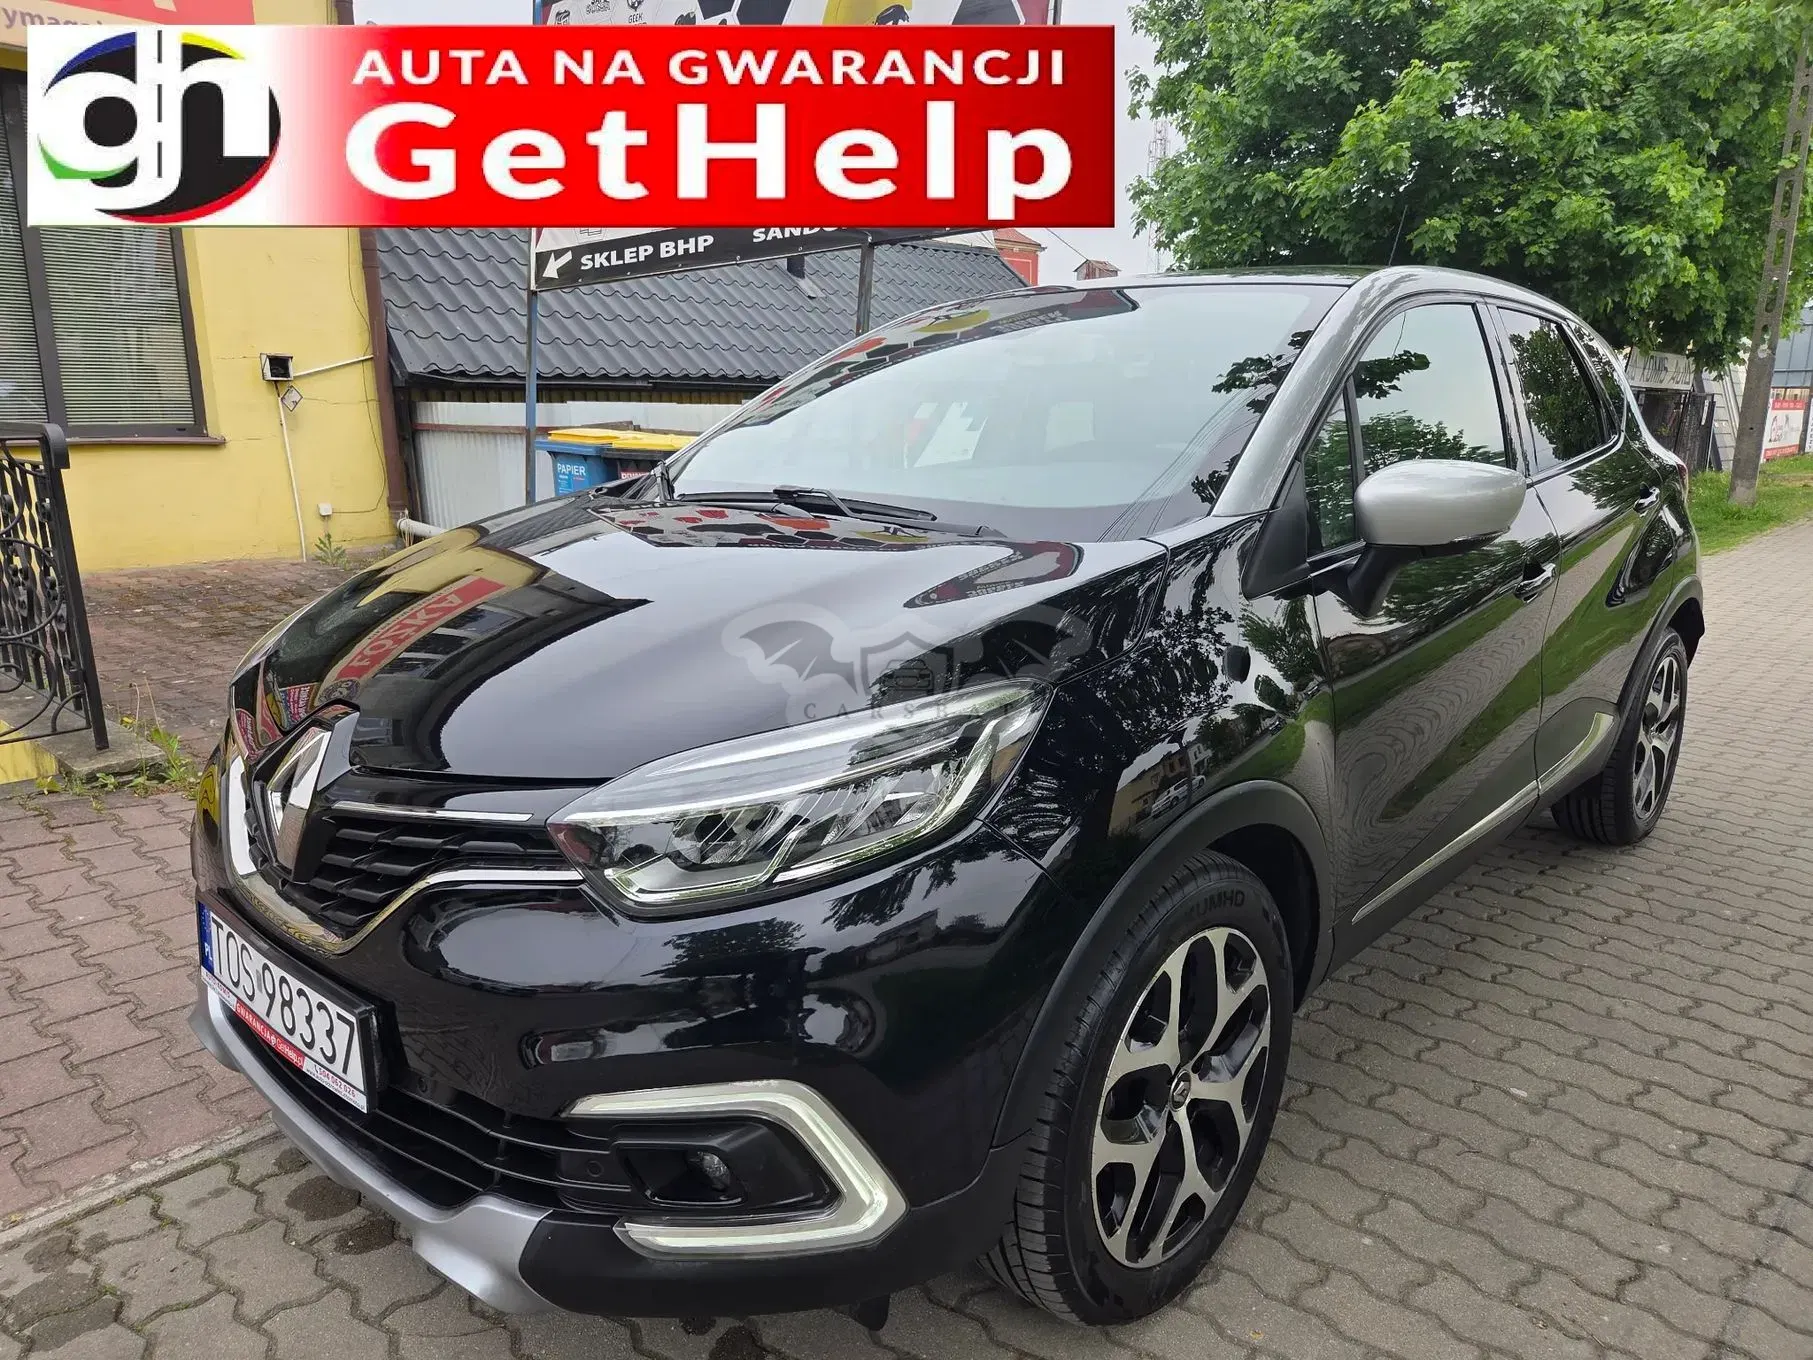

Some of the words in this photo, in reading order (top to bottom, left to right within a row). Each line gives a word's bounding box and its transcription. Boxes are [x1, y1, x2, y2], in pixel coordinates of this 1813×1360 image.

[580, 244, 654, 271] SKLEP
[659, 235, 715, 259] BHP
[557, 463, 586, 476] PAPIER
[204, 942, 213, 961] PL
[210, 915, 256, 1002] TOS
[261, 961, 356, 1076] 98337
